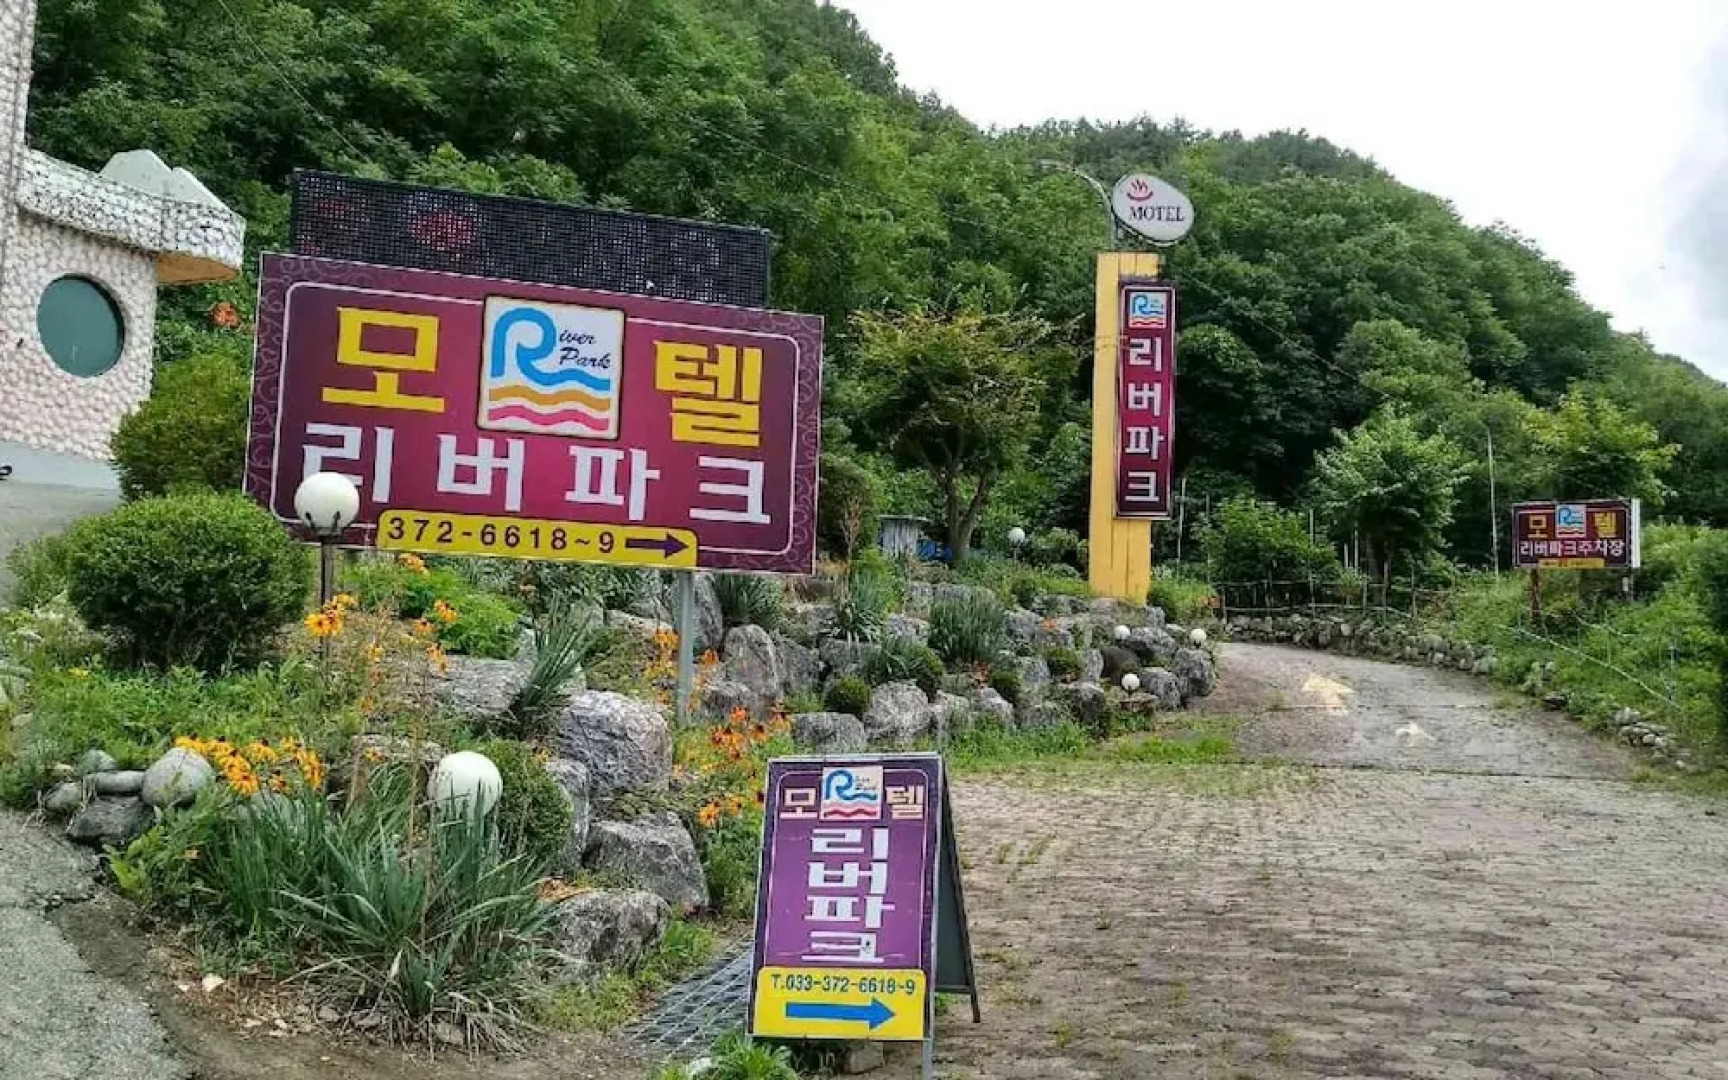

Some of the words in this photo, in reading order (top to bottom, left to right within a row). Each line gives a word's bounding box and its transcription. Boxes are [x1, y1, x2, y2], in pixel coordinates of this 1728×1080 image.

[1129, 205, 1185, 223] MOTEL
[558, 346, 612, 369] Park
[1124, 336, 1165, 502] 리버파크
[302, 422, 772, 526] 리버파크
[387, 516, 615, 554] 372-6618~9
[801, 827, 896, 963] 리버파크
[771, 973, 915, 996] T.033-372-6618-9
